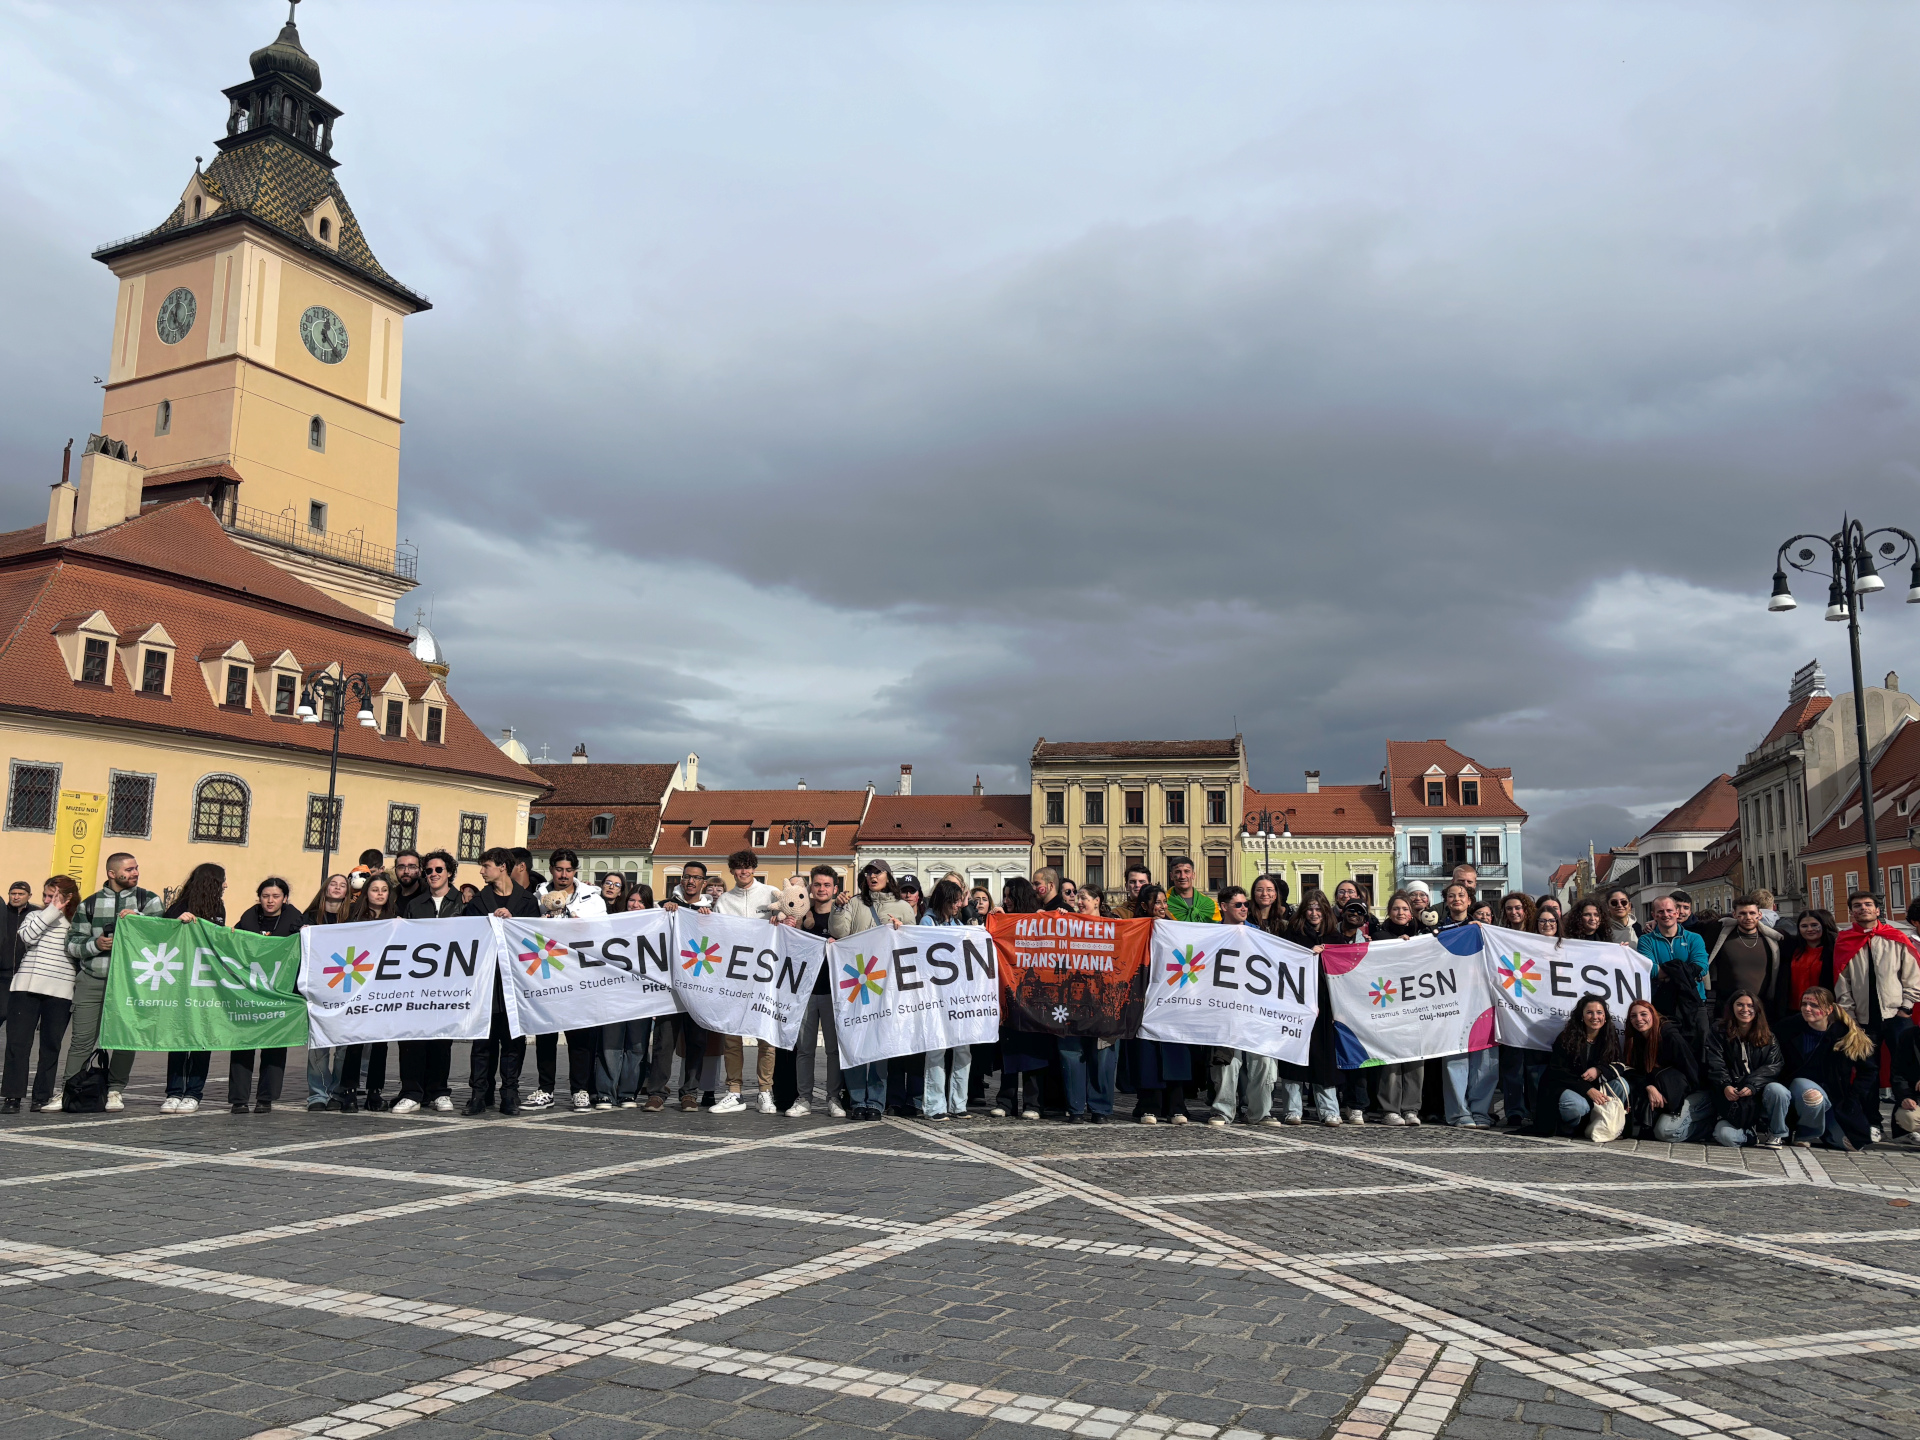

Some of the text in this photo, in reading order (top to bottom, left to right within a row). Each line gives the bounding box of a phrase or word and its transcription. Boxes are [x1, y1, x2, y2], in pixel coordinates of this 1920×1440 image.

[1015, 917, 1115, 939] HALLOWEEN
[568, 932, 669, 975] ESN
[1058, 940, 1068, 949] IN
[374, 939, 479, 981] ESN
[725, 945, 808, 995] ESN
[892, 938, 996, 992] ESN
[1015, 952, 1114, 972] TRANSYLVANIA
[523, 984, 574, 999] Erasmus
[579, 974, 627, 990] Student
[1213, 948, 1305, 1005] ESN
[1400, 968, 1457, 1002] ESN
[1549, 960, 1643, 1005] ESN
[125, 997, 287, 1008] Erasmus Student Network
[368, 989, 415, 1000] Student
[420, 987, 472, 998] Network
[674, 979, 714, 994] Erasmus
[718, 987, 755, 999] Student
[758, 992, 793, 1012] Network
[345, 1000, 471, 1016] ASE-CMP Bucharest
[750, 1002, 771, 1016] Alba
[843, 992, 998, 1028] Erasmus Student Network
[948, 1006, 998, 1021] Romania
[1208, 998, 1255, 1014] Student
[1259, 1006, 1304, 1026] Network
[1370, 1000, 1459, 1020] Erasmus Student Network
[1419, 1009, 1460, 1021] Cluj-Napoca
[1497, 998, 1544, 1015] Erasmus
[1281, 1025, 1302, 1039] Poli
